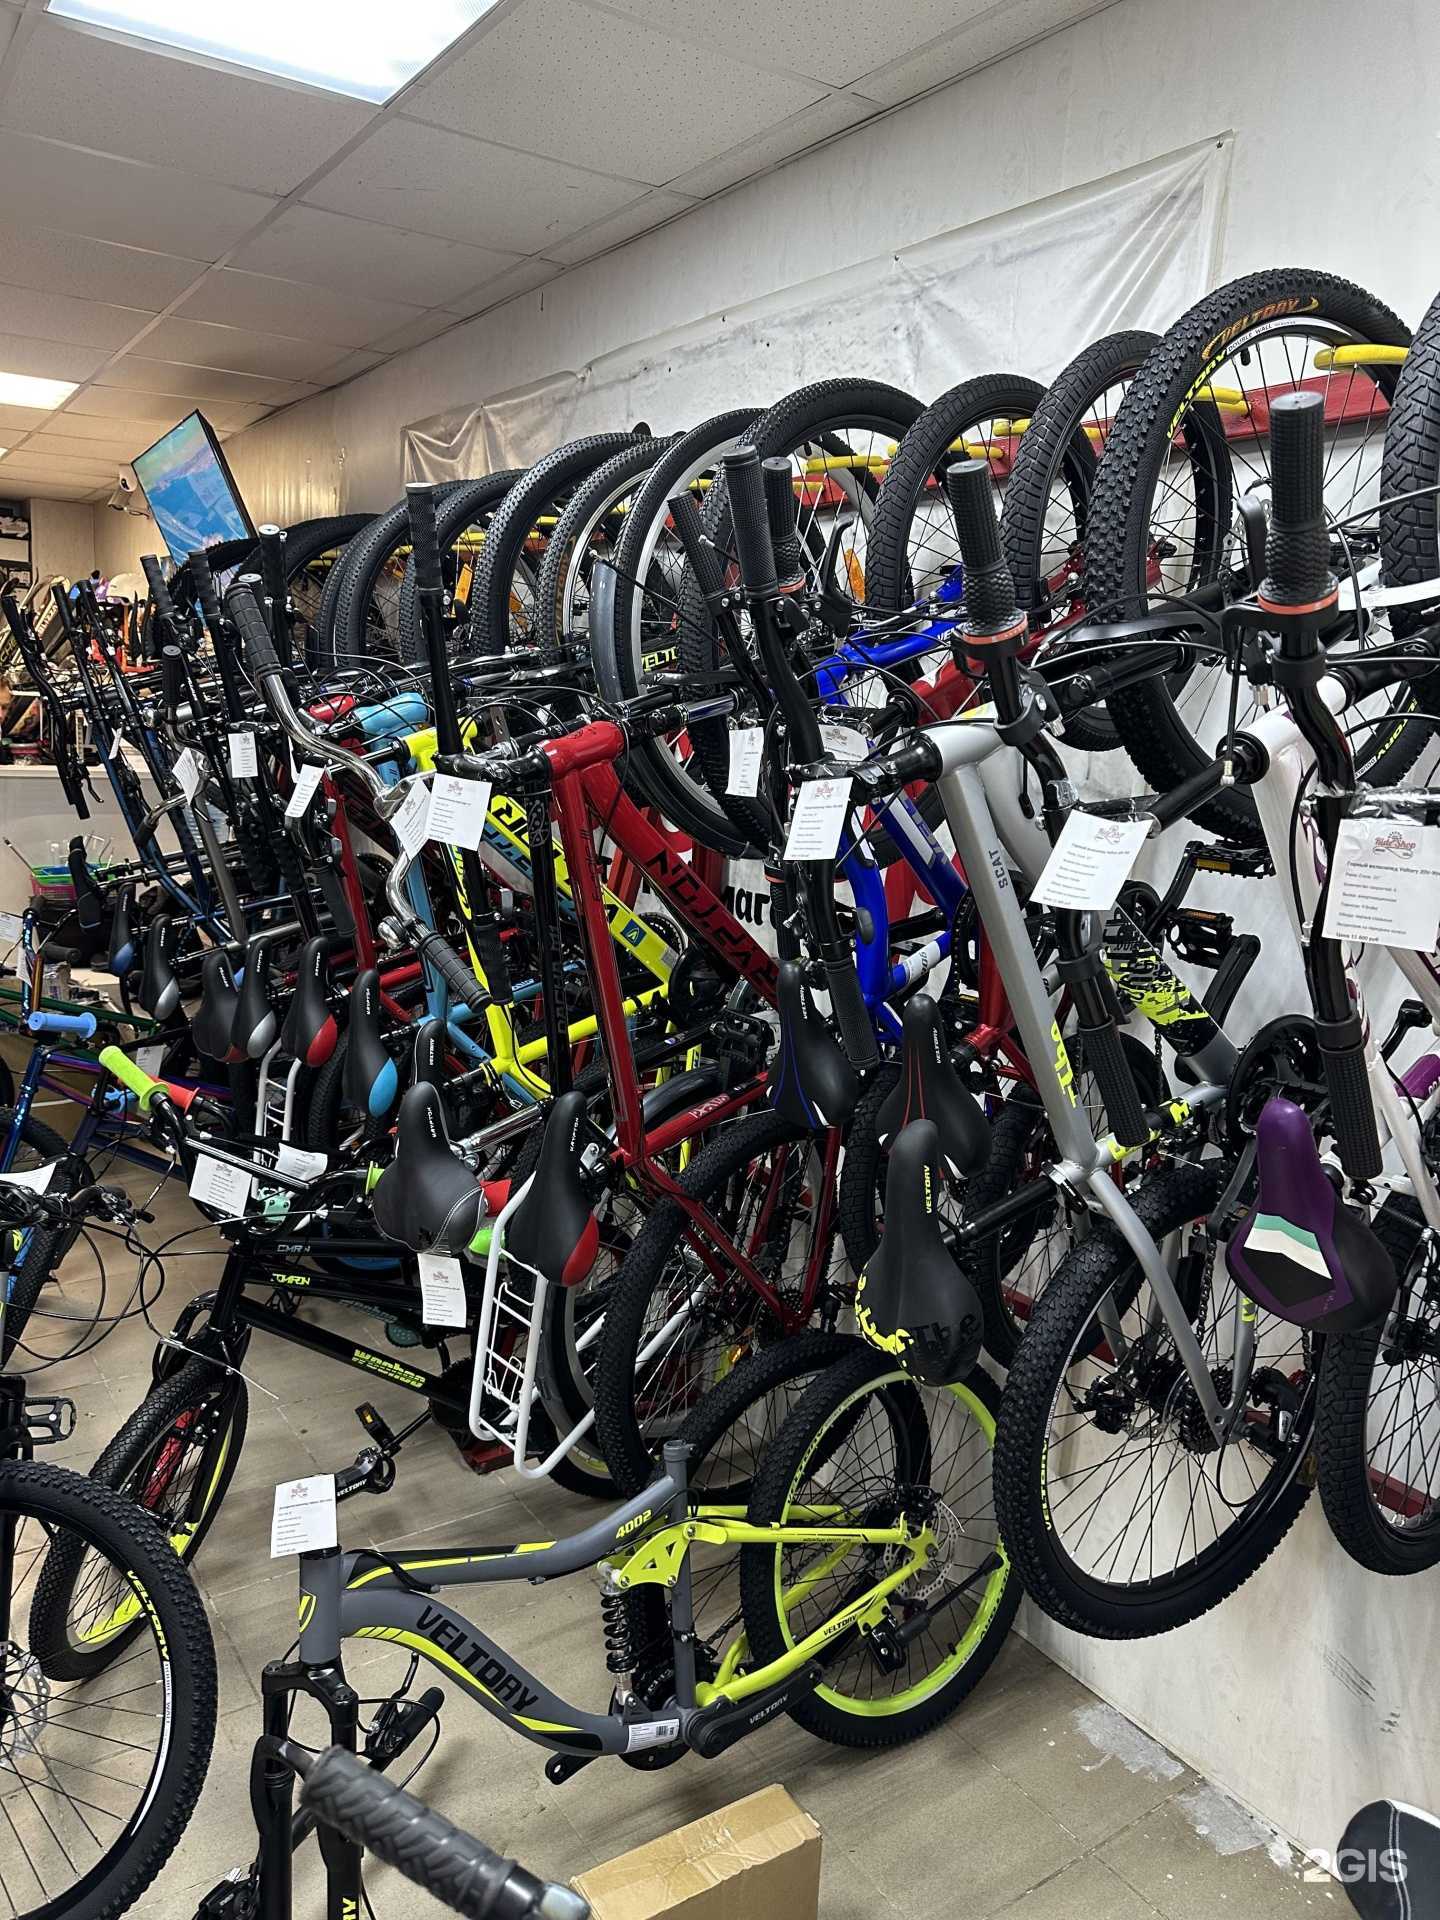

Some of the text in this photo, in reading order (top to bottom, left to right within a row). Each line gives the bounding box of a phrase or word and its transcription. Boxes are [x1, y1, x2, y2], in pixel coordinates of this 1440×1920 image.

[1166, 349, 1227, 439] VELTORY
[1227, 332, 1253, 353] DOUBLE
[989, 849, 1009, 890] SCAT
[923, 1165, 933, 1214] VELTORY
[615, 1510, 652, 1539] 4002
[128, 1570, 169, 1660] VELTORY
[823, 1614, 858, 1637] VELTORY
[416, 1605, 539, 1711] VELTORY
[749, 1694, 789, 1727] VELTORY
